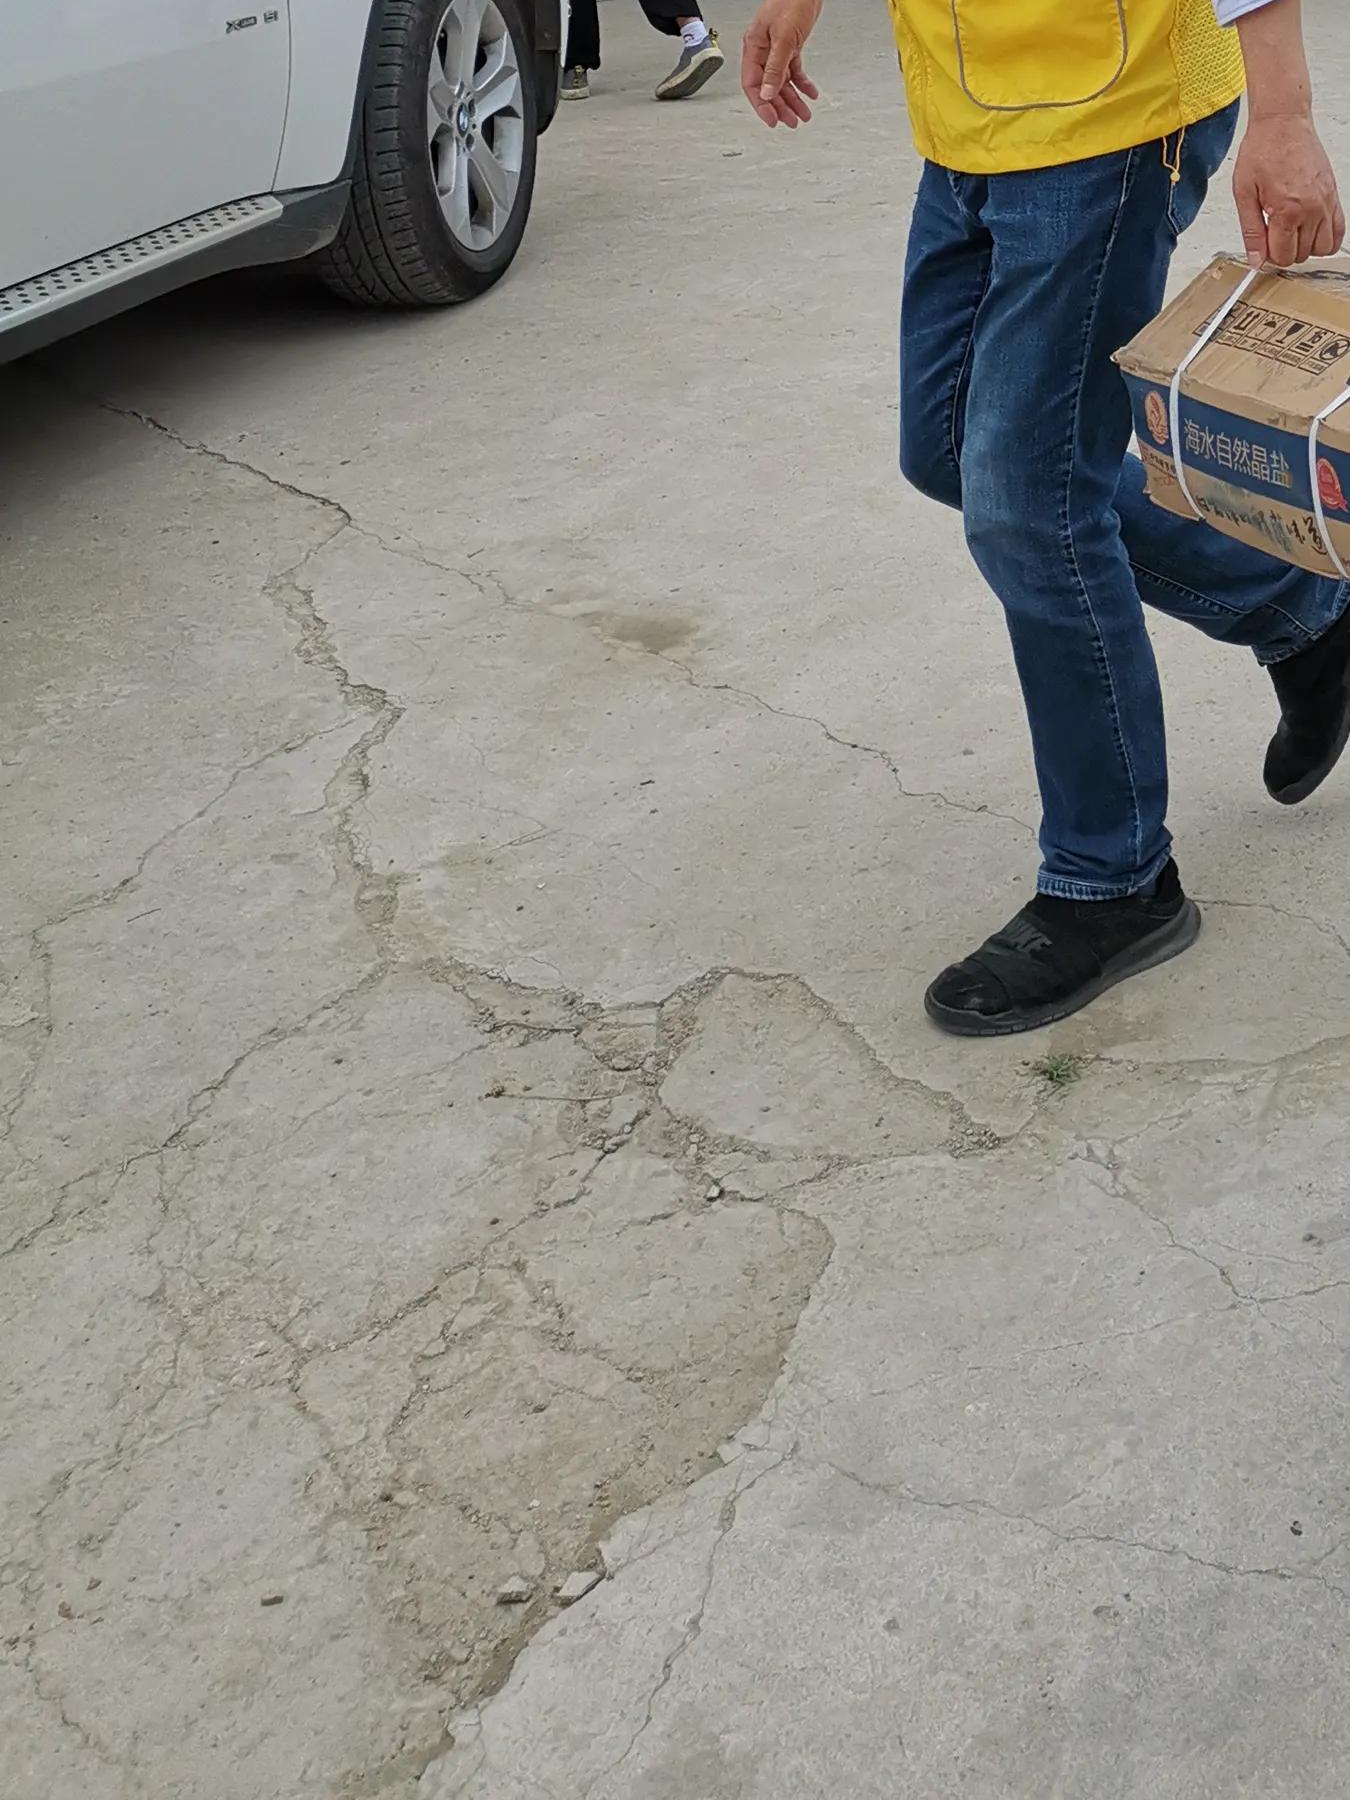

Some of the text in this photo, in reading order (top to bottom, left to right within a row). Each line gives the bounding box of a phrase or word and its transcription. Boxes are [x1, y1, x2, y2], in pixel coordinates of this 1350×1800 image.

[1183, 417, 1291, 489] 海水自然晶盐
